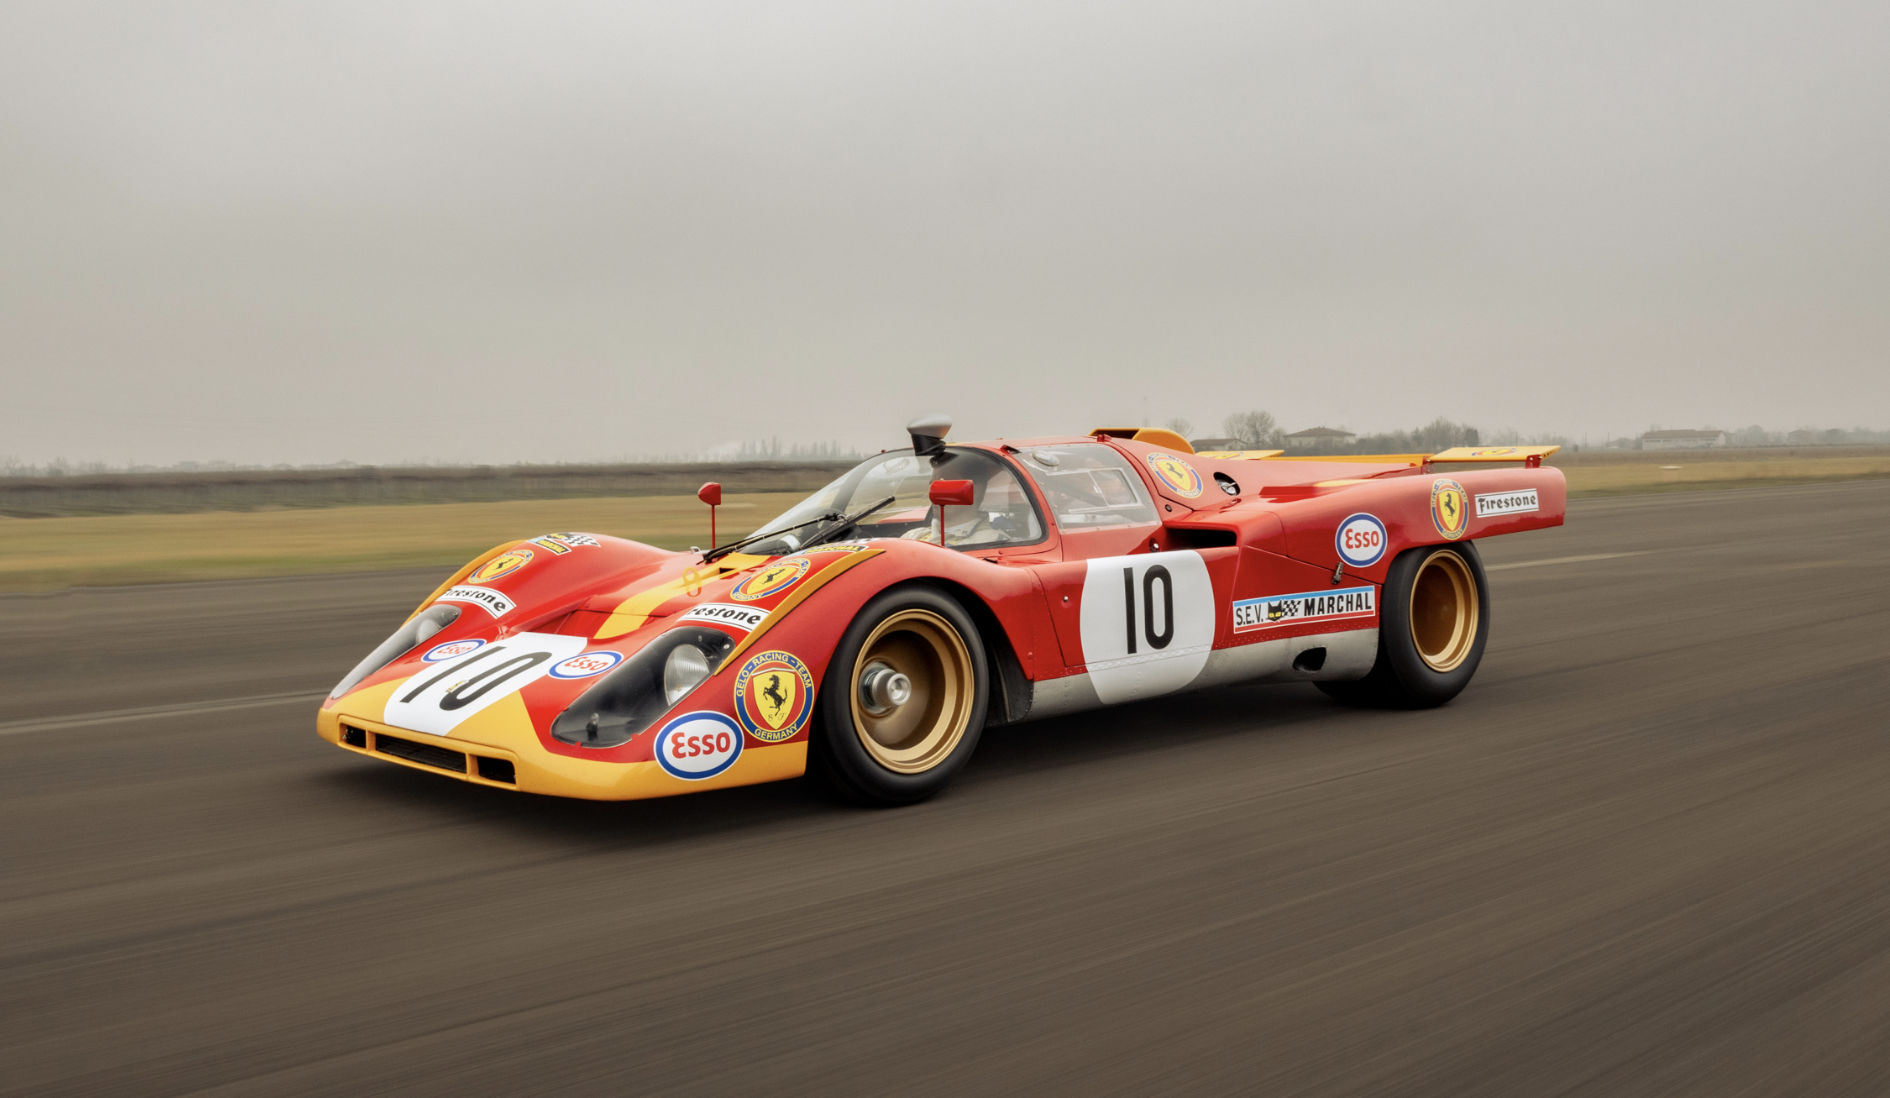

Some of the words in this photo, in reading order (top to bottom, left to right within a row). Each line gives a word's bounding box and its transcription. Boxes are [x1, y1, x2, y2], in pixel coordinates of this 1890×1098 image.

[1478, 495, 1536, 514] Firestone
[1123, 564, 1174, 655] 10
[1236, 604, 1263, 626] S.E.V.
[1304, 592, 1372, 617] MARCHAL
[400, 646, 553, 711] 10
[754, 723, 798, 740] GERMANY
